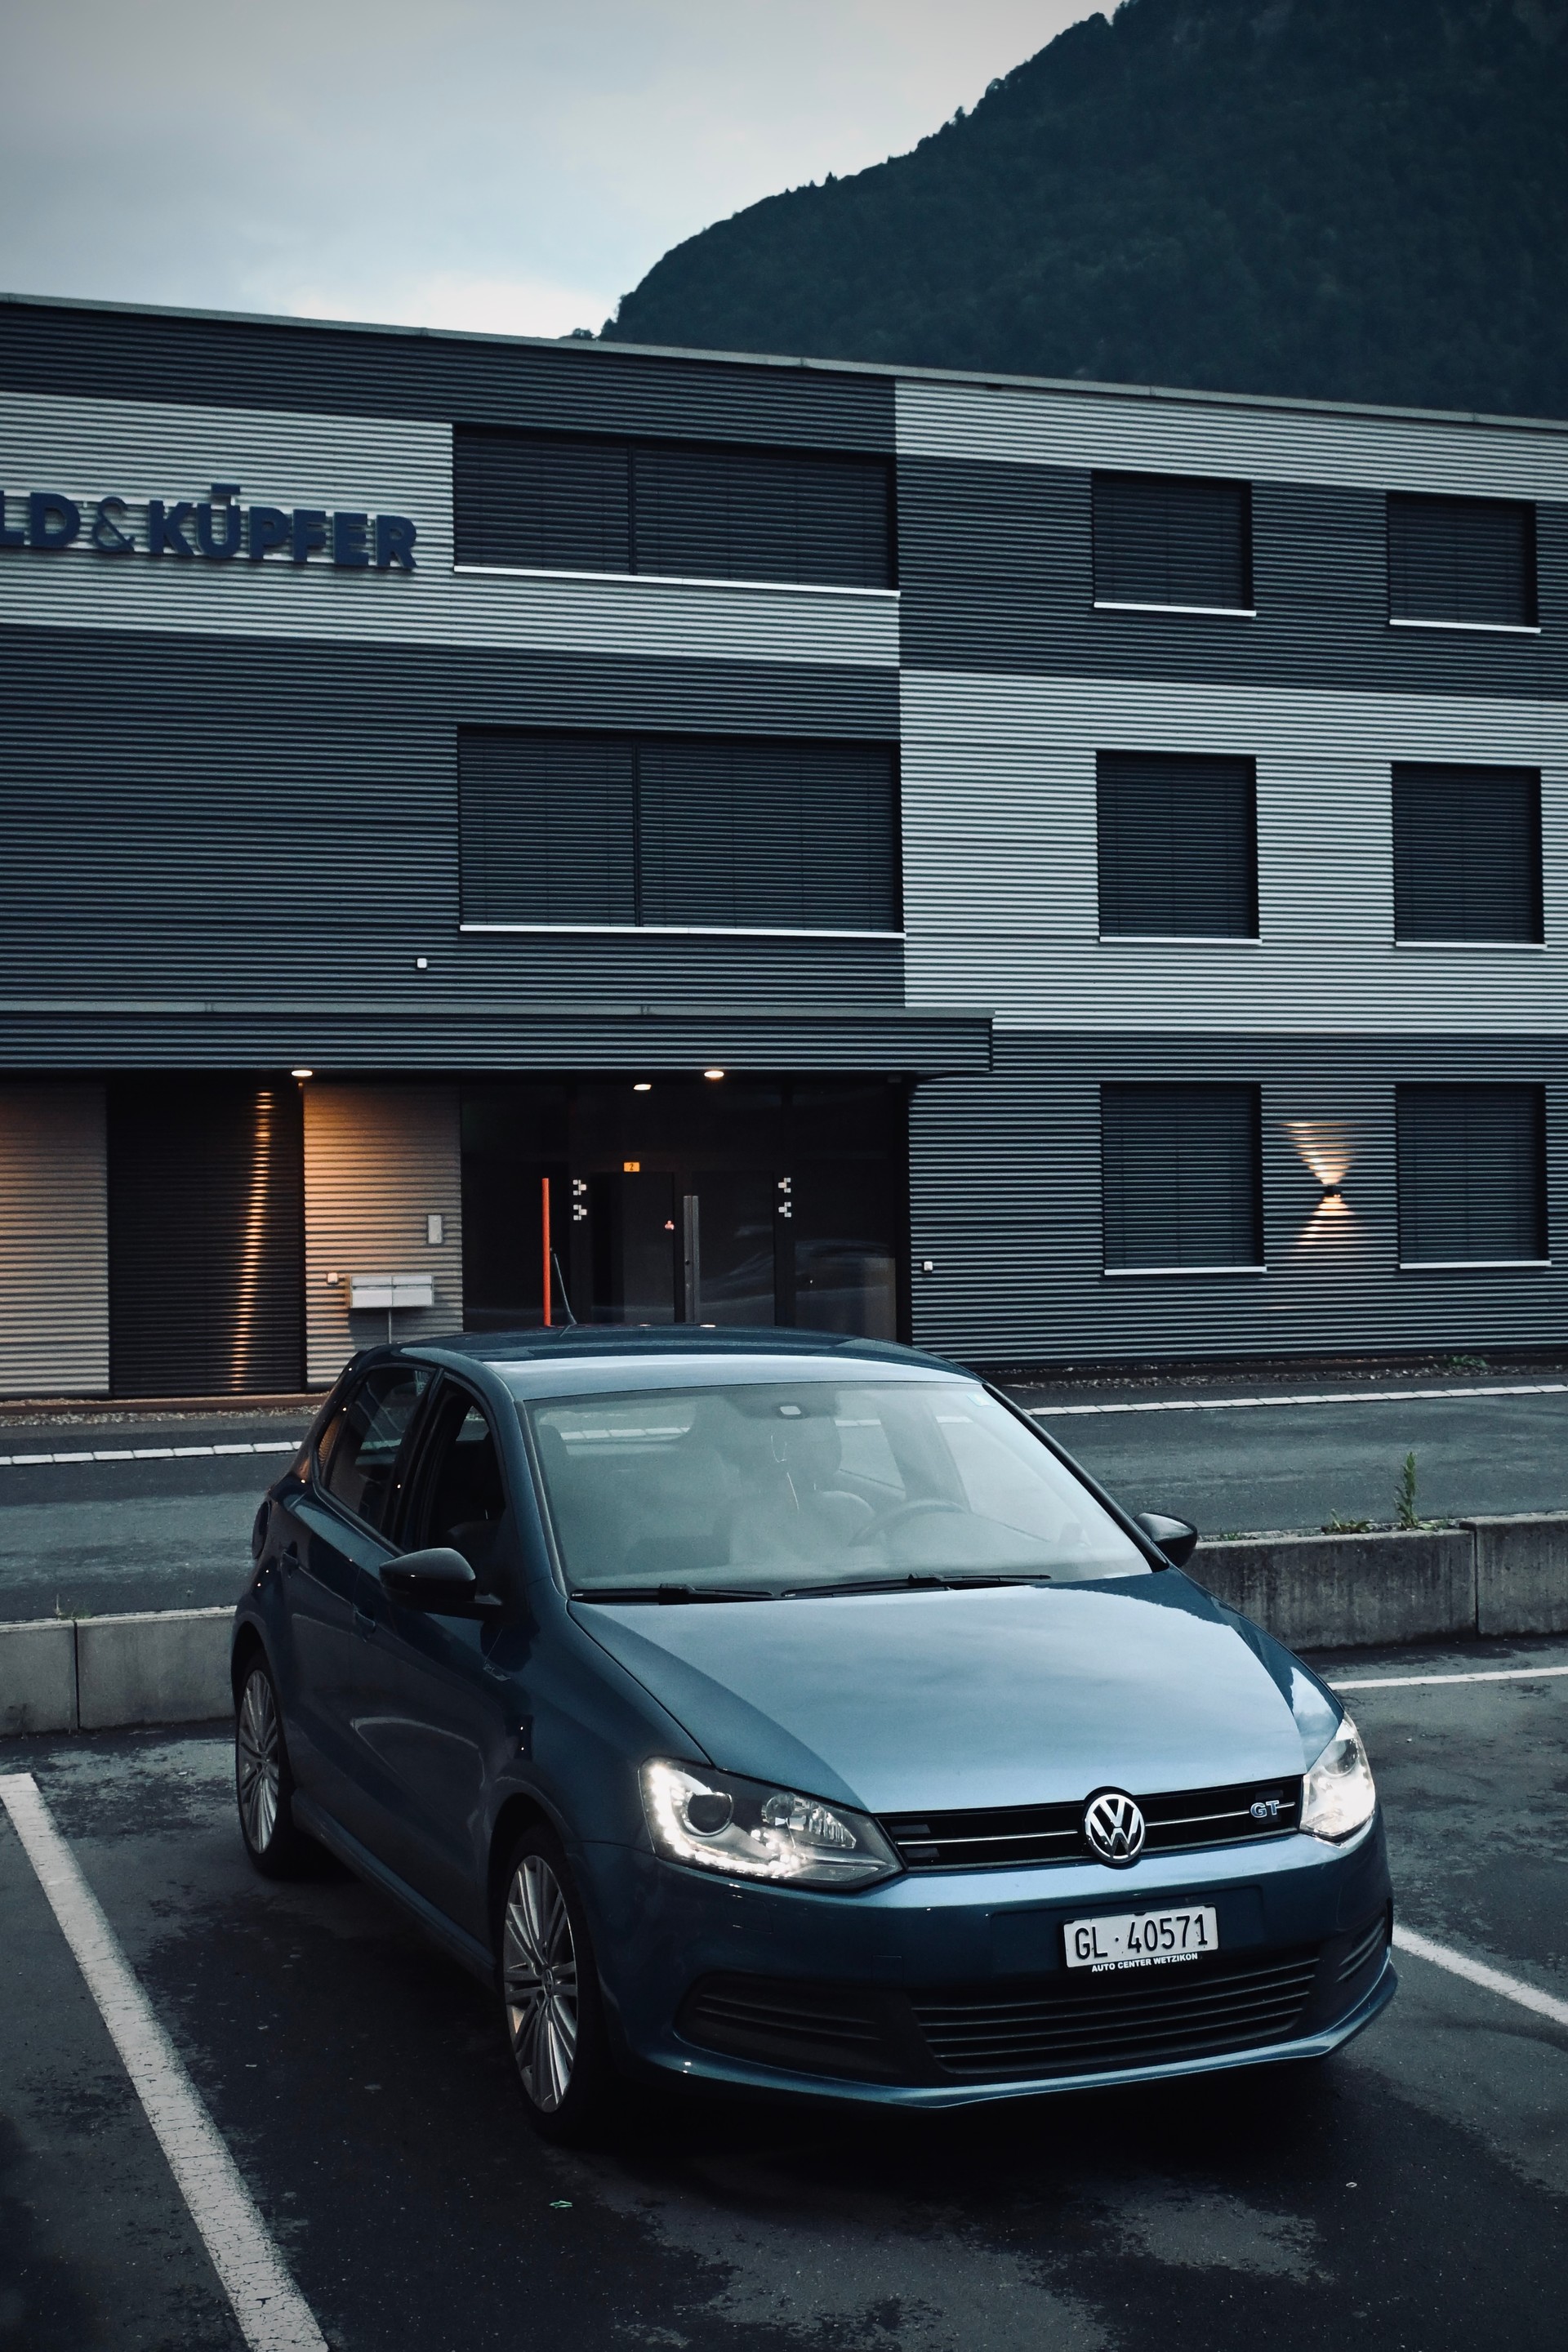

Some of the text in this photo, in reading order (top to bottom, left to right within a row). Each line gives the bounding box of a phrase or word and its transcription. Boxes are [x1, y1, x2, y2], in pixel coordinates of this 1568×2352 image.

[1250, 1800, 1280, 1819] GT
[1075, 1913, 1208, 1959] GL 40571
[1091, 1953, 1198, 1973] AUTO CENTER WETZIKON
